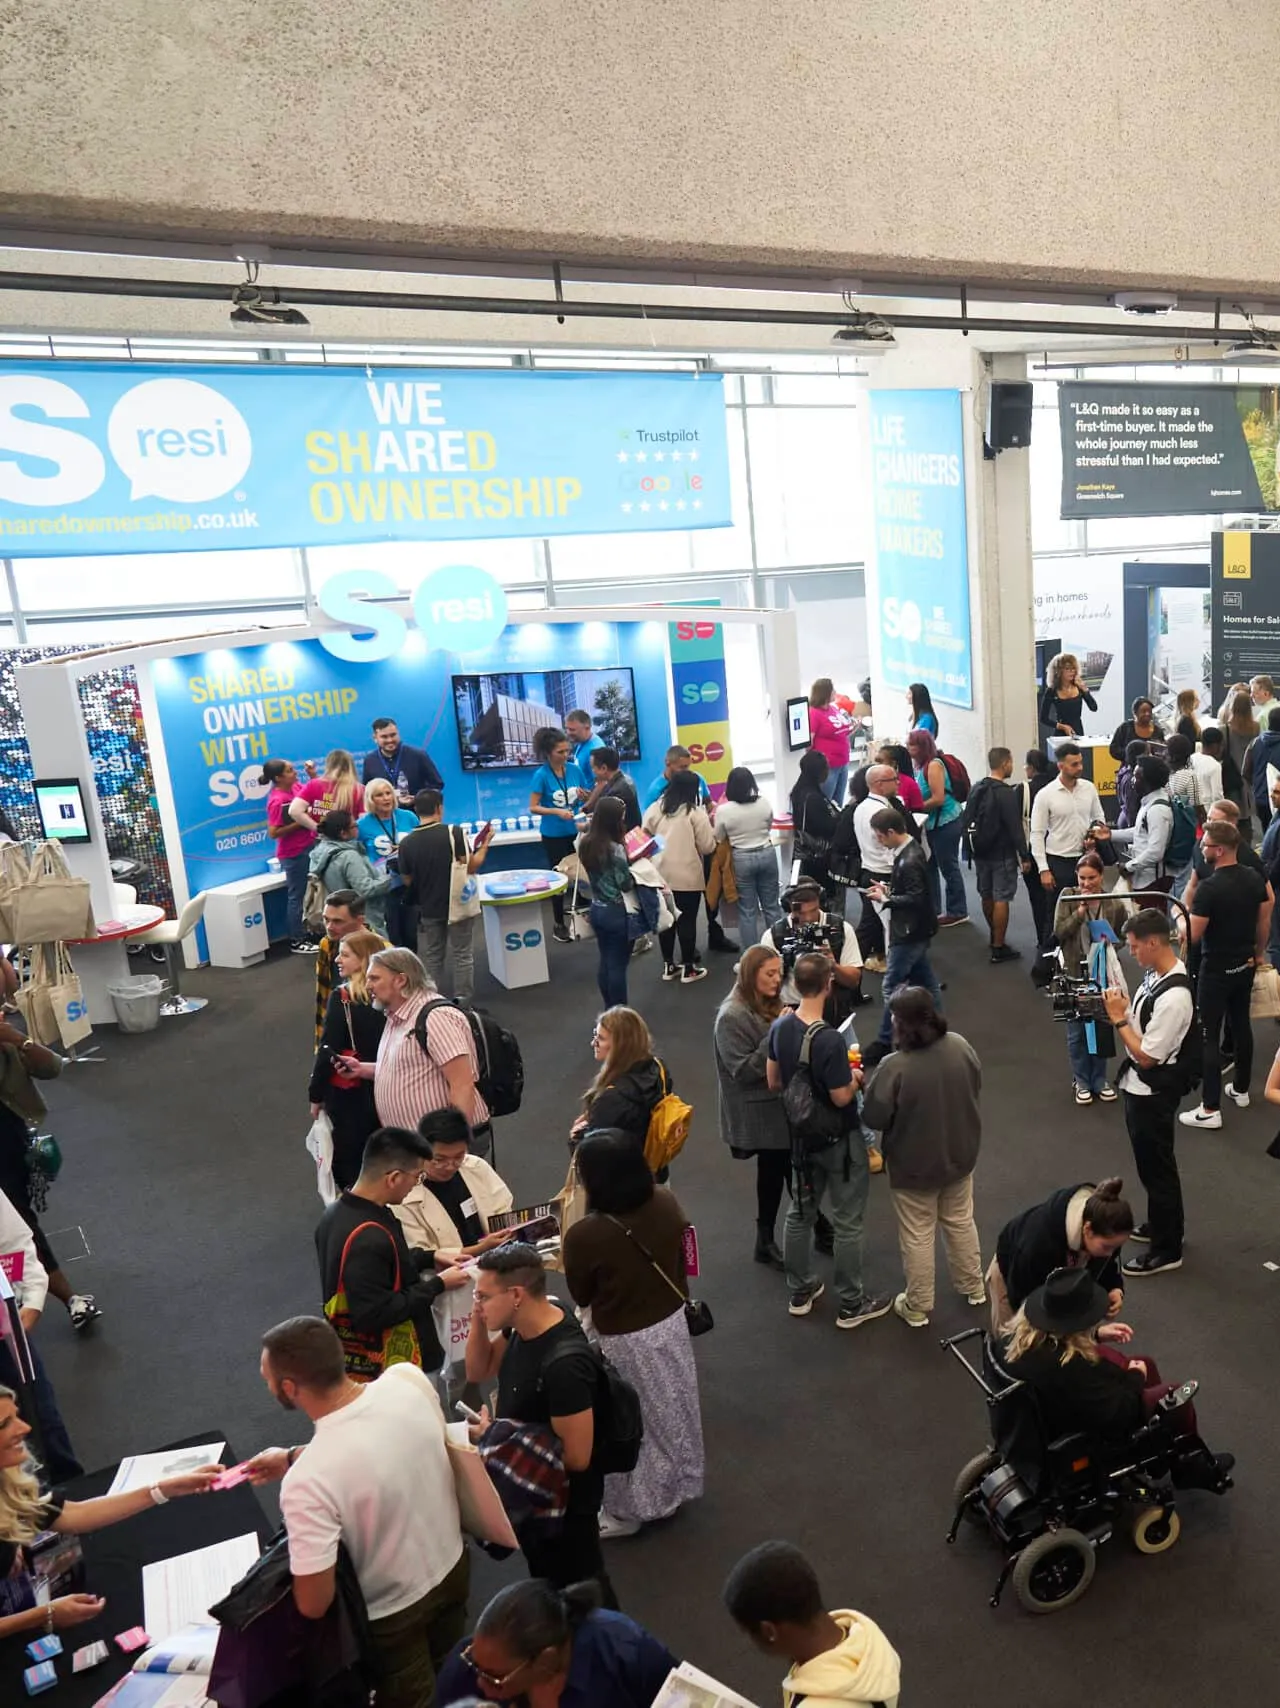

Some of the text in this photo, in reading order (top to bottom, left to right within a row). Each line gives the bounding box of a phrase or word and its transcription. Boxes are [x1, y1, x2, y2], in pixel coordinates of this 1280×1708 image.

[367, 382, 446, 425] WE
[1102, 403, 1130, 416] made
[1132, 403, 1140, 416] it
[1142, 405, 1153, 416] so
[1156, 405, 1177, 418] easy
[1181, 406, 1191, 416] as
[1194, 406, 1200, 416] a
[136, 419, 228, 458] resi
[636, 428, 700, 444] Trustpilot
[1075, 420, 1213, 435] first-time buyer. It made the
[305, 430, 497, 475] SHARED
[1075, 436, 1198, 452] whole journey much less
[1075, 453, 1119, 467] stressful
[1122, 454, 1143, 466] than
[1152, 454, 1170, 466] had
[308, 476, 583, 525] OWNERSHIP
[0, 509, 260, 536] haredownership.co.uk
[431, 590, 494, 624] resi
[1223, 615, 1252, 624] Homes
[1253, 615, 1265, 624] for
[189, 666, 295, 704] SHARED
[203, 687, 359, 735] OWNERSHIP
[90, 749, 132, 774] esi
[200, 731, 270, 767] WITH
[216, 829, 268, 852] 020 8607
